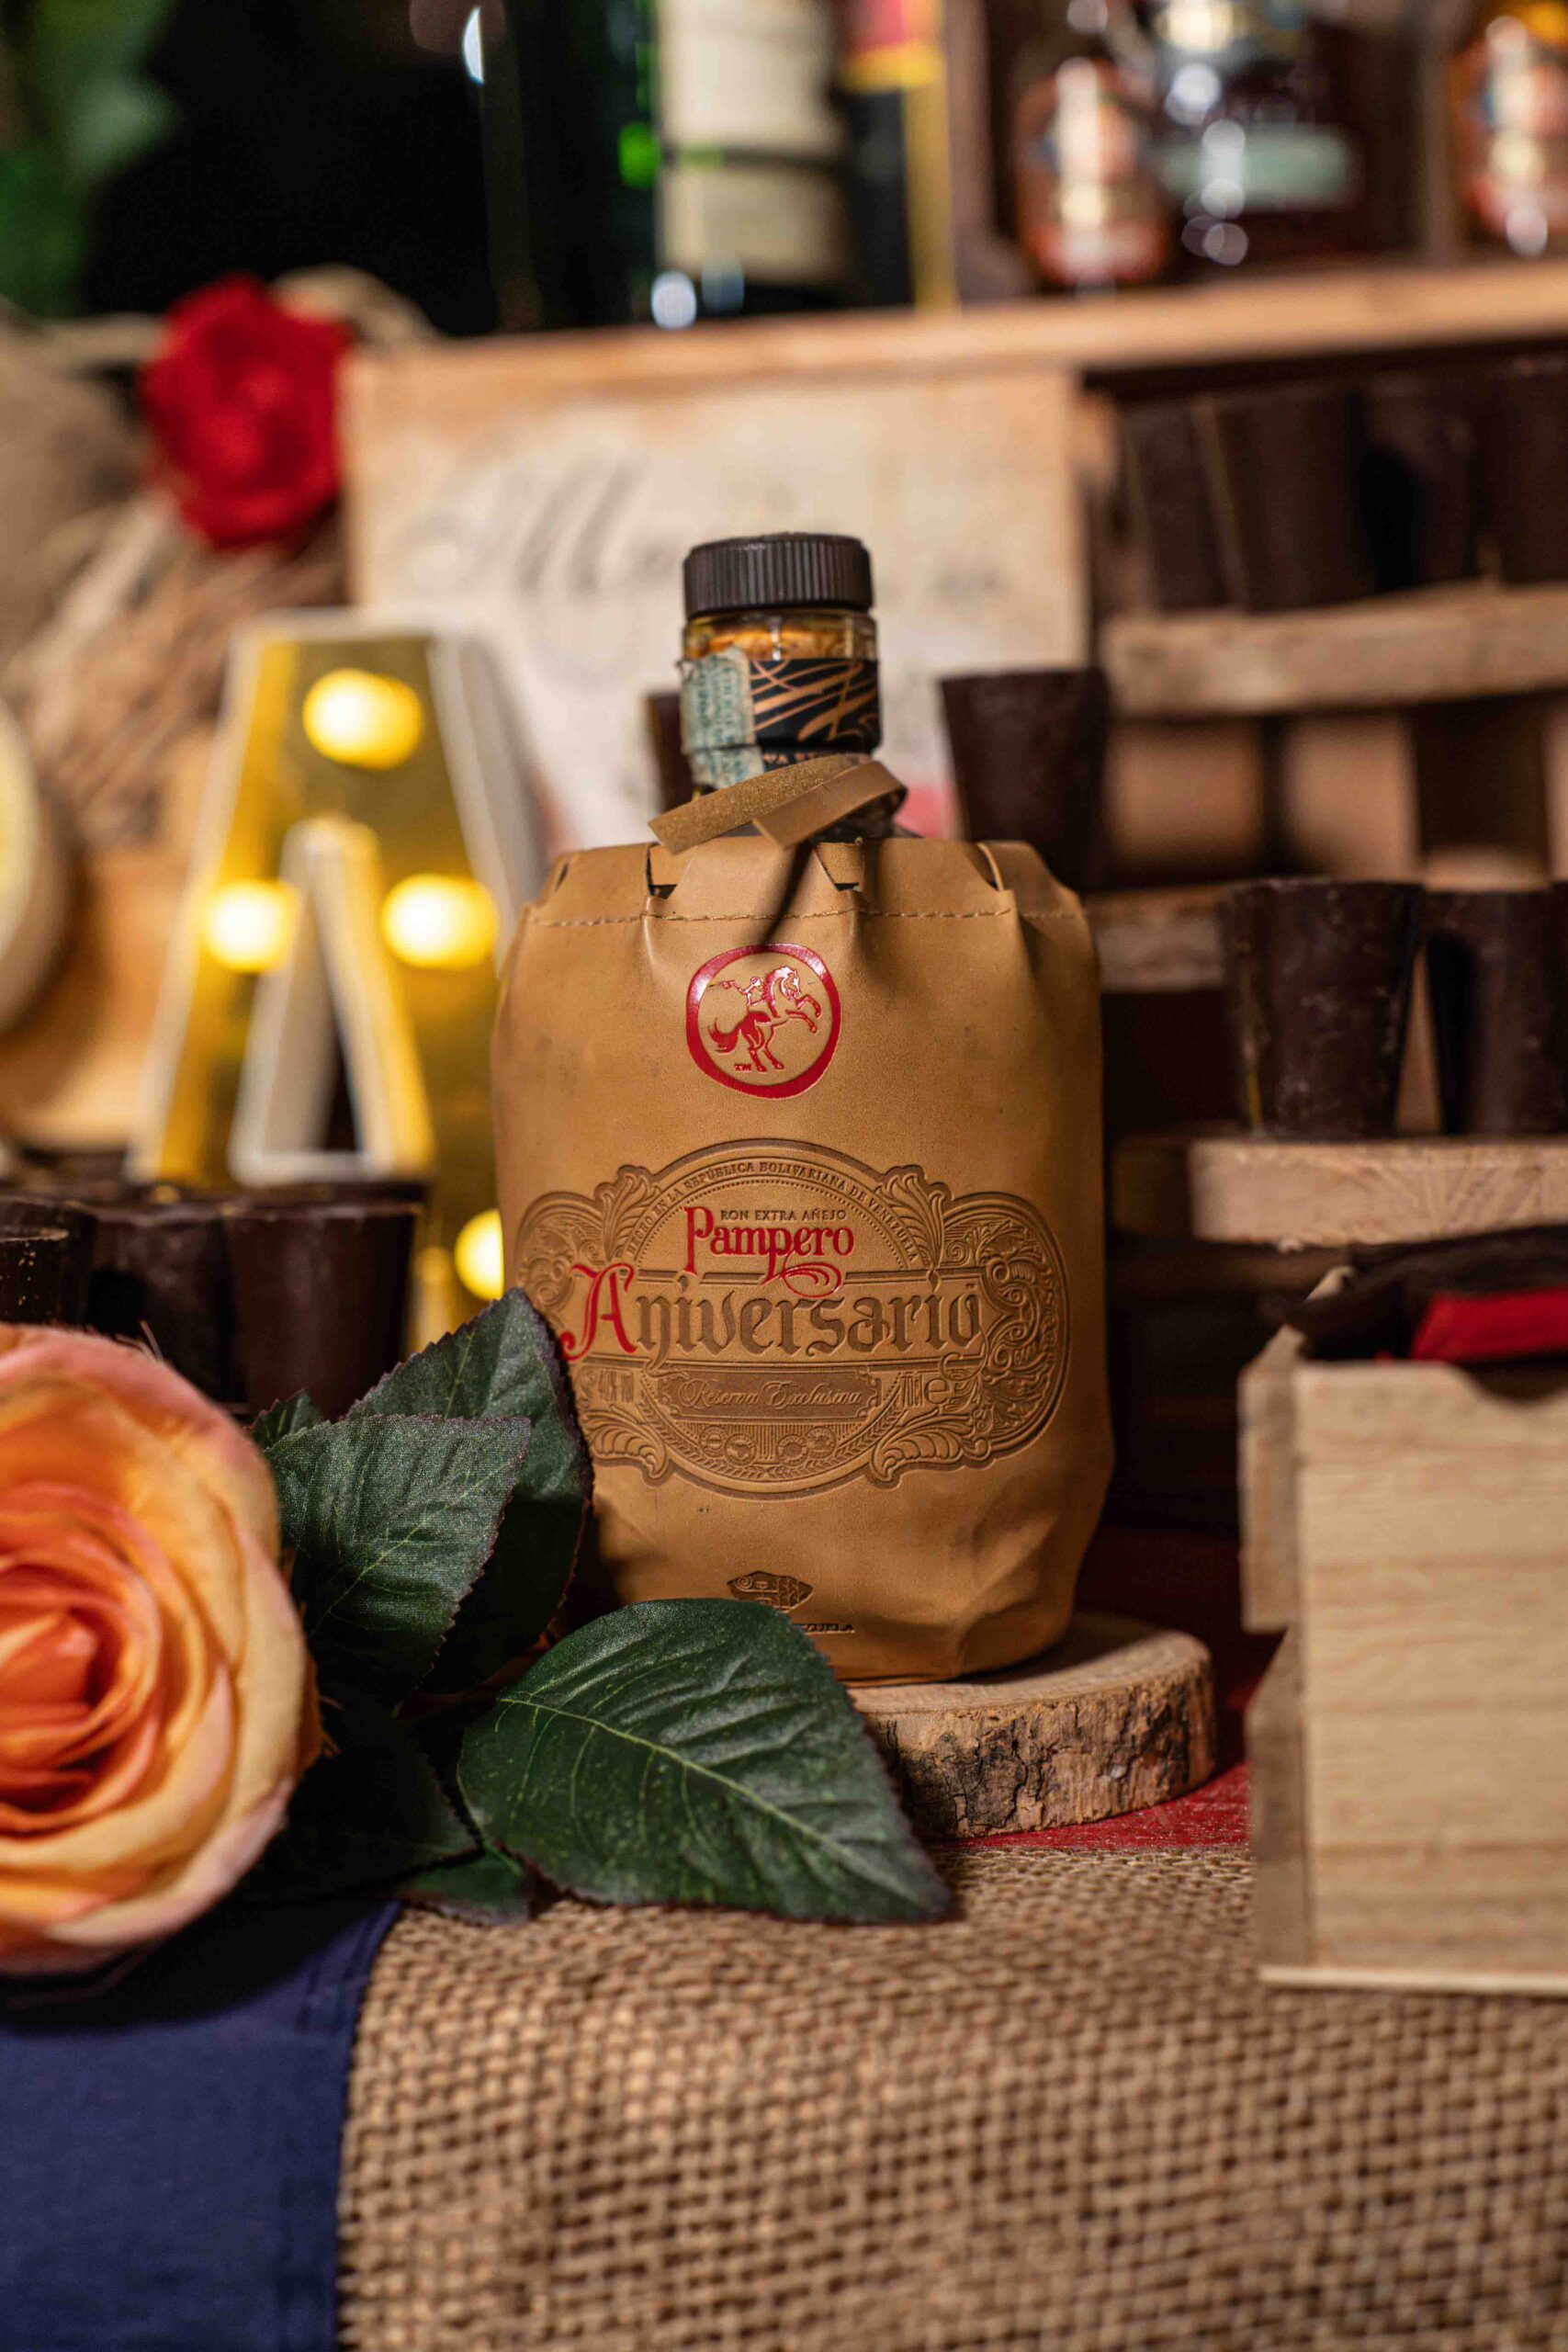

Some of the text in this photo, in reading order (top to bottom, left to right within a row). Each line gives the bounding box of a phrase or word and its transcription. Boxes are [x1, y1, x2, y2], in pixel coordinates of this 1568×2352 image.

[626, 1161, 919, 1261] HECHO EN LA REPÚBLICA BOLIVARIANA DE VENEZUELA
[683, 1206, 854, 1297] Pampero
[720, 1208, 847, 1221] RON EXTRA AÑEJO
[558, 1262, 981, 1376] Aniversario
